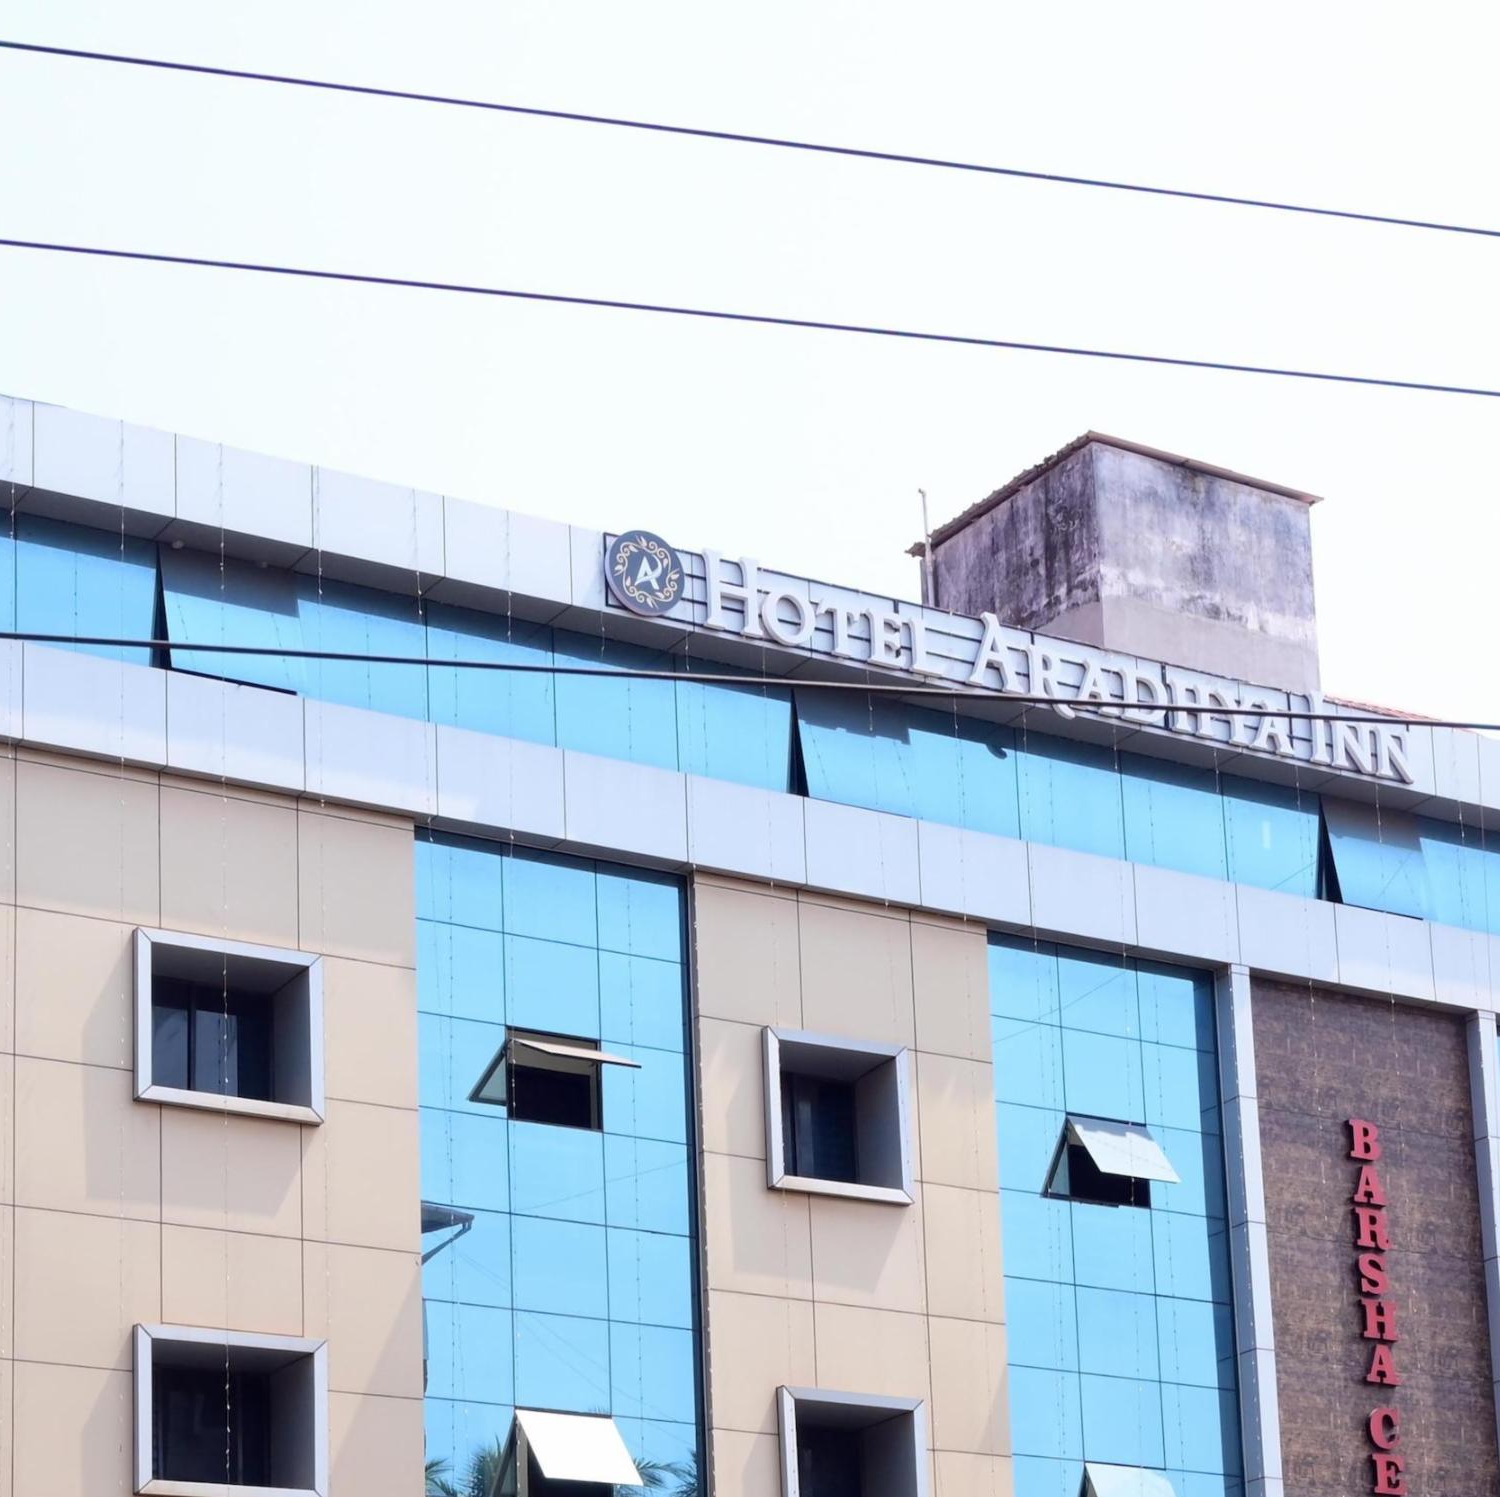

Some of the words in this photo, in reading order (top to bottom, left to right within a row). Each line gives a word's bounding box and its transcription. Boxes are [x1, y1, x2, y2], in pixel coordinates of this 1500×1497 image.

[702, 548, 943, 678] HOTEL
[967, 610, 1296, 757] ARADHYA
[1311, 690, 1415, 784] INN
[1346, 1119, 1400, 1385] BARSHA
